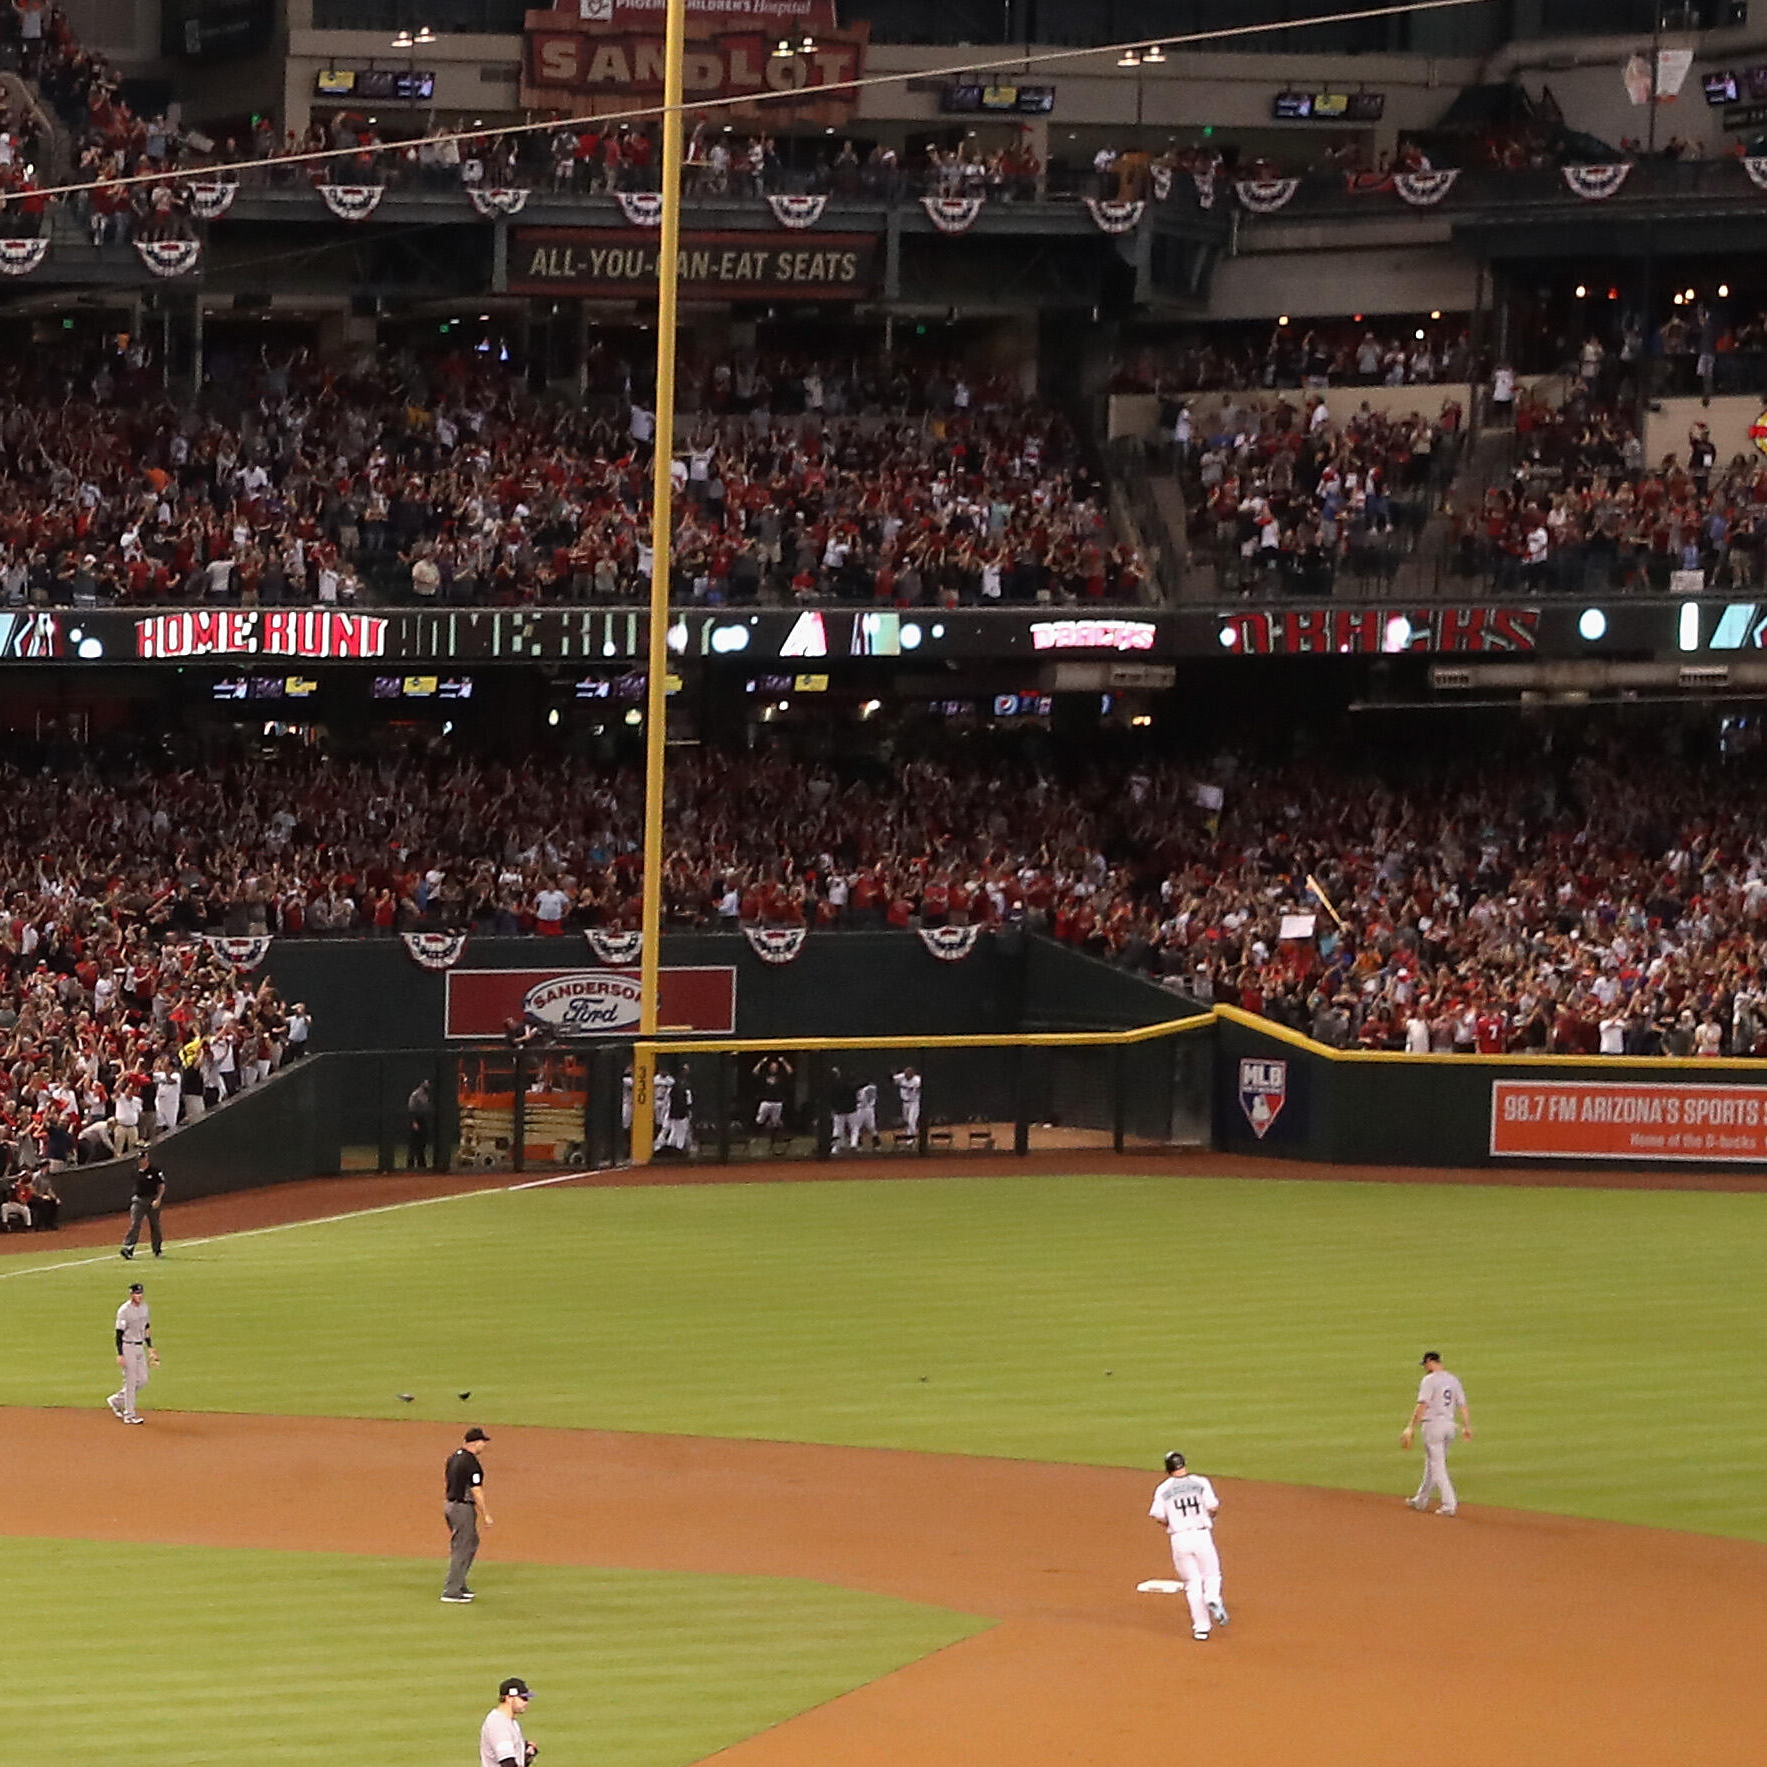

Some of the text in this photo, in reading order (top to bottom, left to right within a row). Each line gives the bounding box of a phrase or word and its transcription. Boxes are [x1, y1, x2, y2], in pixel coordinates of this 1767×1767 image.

[539, 40, 851, 91] SANDLOT
[529, 248, 858, 281] ALL-YOU-AN-EAT SEATS
[135, 612, 259, 657] HOME
[564, 998, 619, 1023] Ford
[1488, 1024, 1499, 1040] 7
[1243, 1064, 1283, 1086] MLB
[1548, 1096, 1577, 1122] FM
[1581, 1096, 1679, 1124] ARIZONA'S
[1683, 1097, 1759, 1126] SPORTS
[1174, 1495, 1200, 1517] 44
